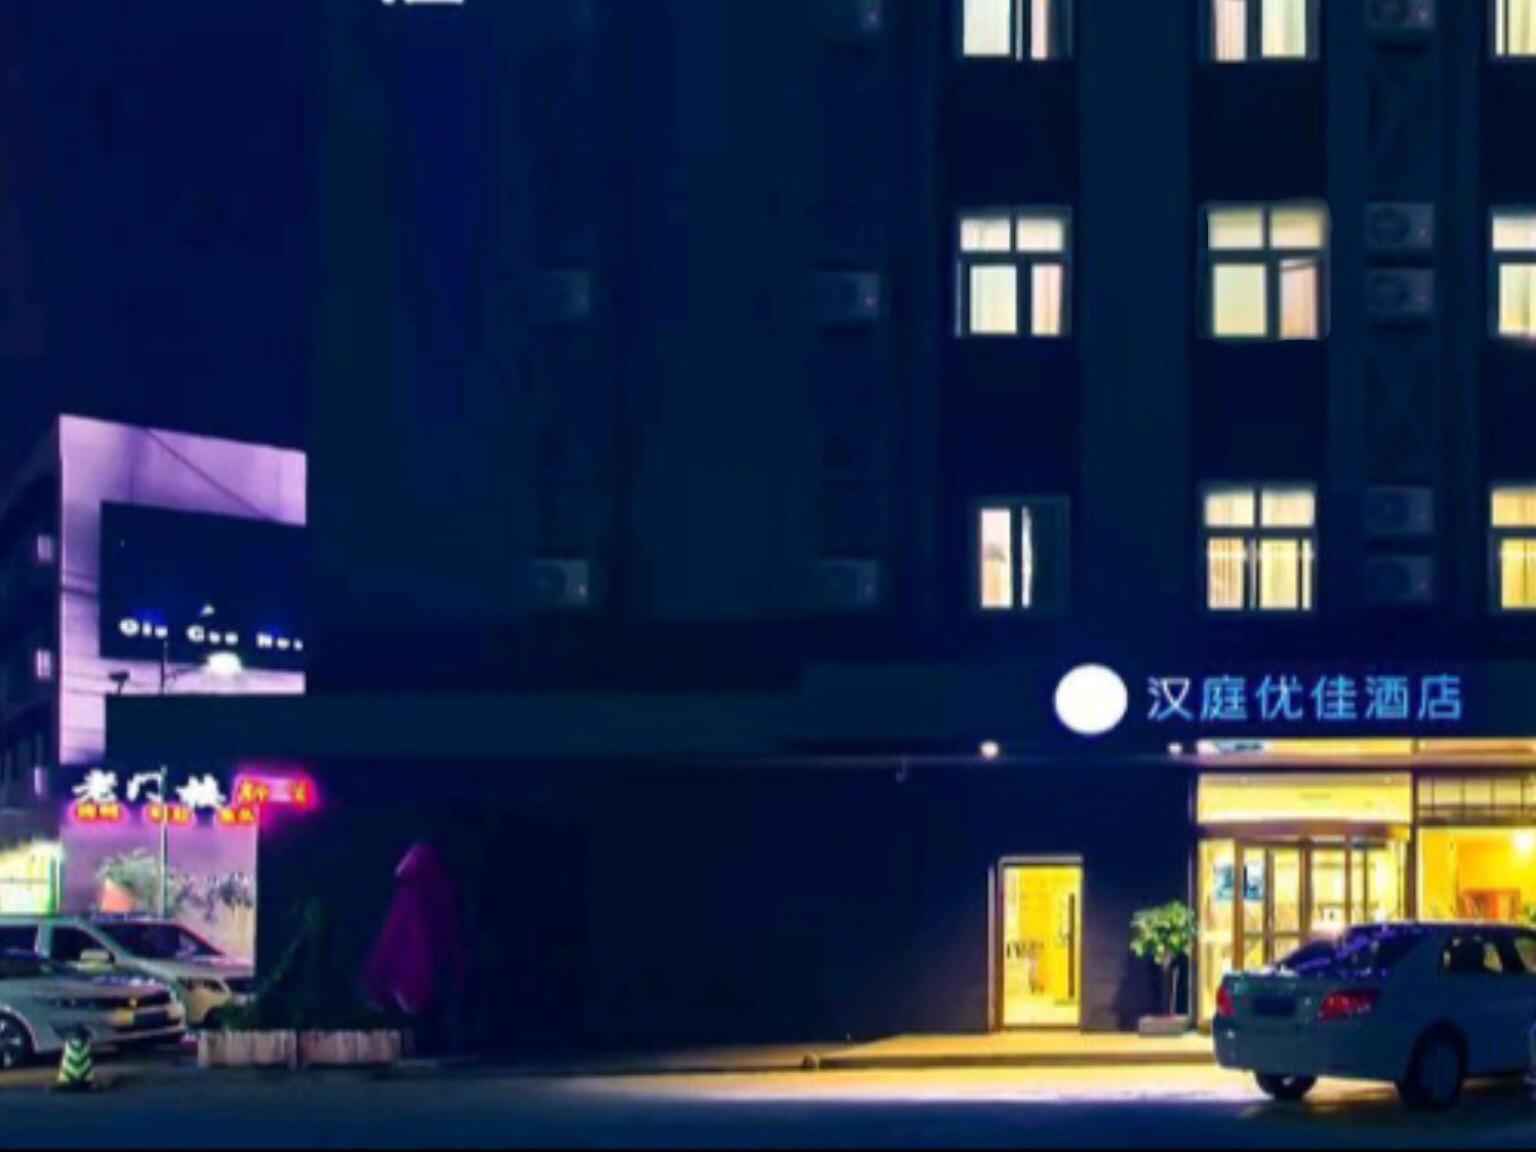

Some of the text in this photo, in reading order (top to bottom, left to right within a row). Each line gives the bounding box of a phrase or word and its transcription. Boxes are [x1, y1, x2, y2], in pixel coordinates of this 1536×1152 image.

[1146, 674, 1464, 722] 汉庭优佳酒店
